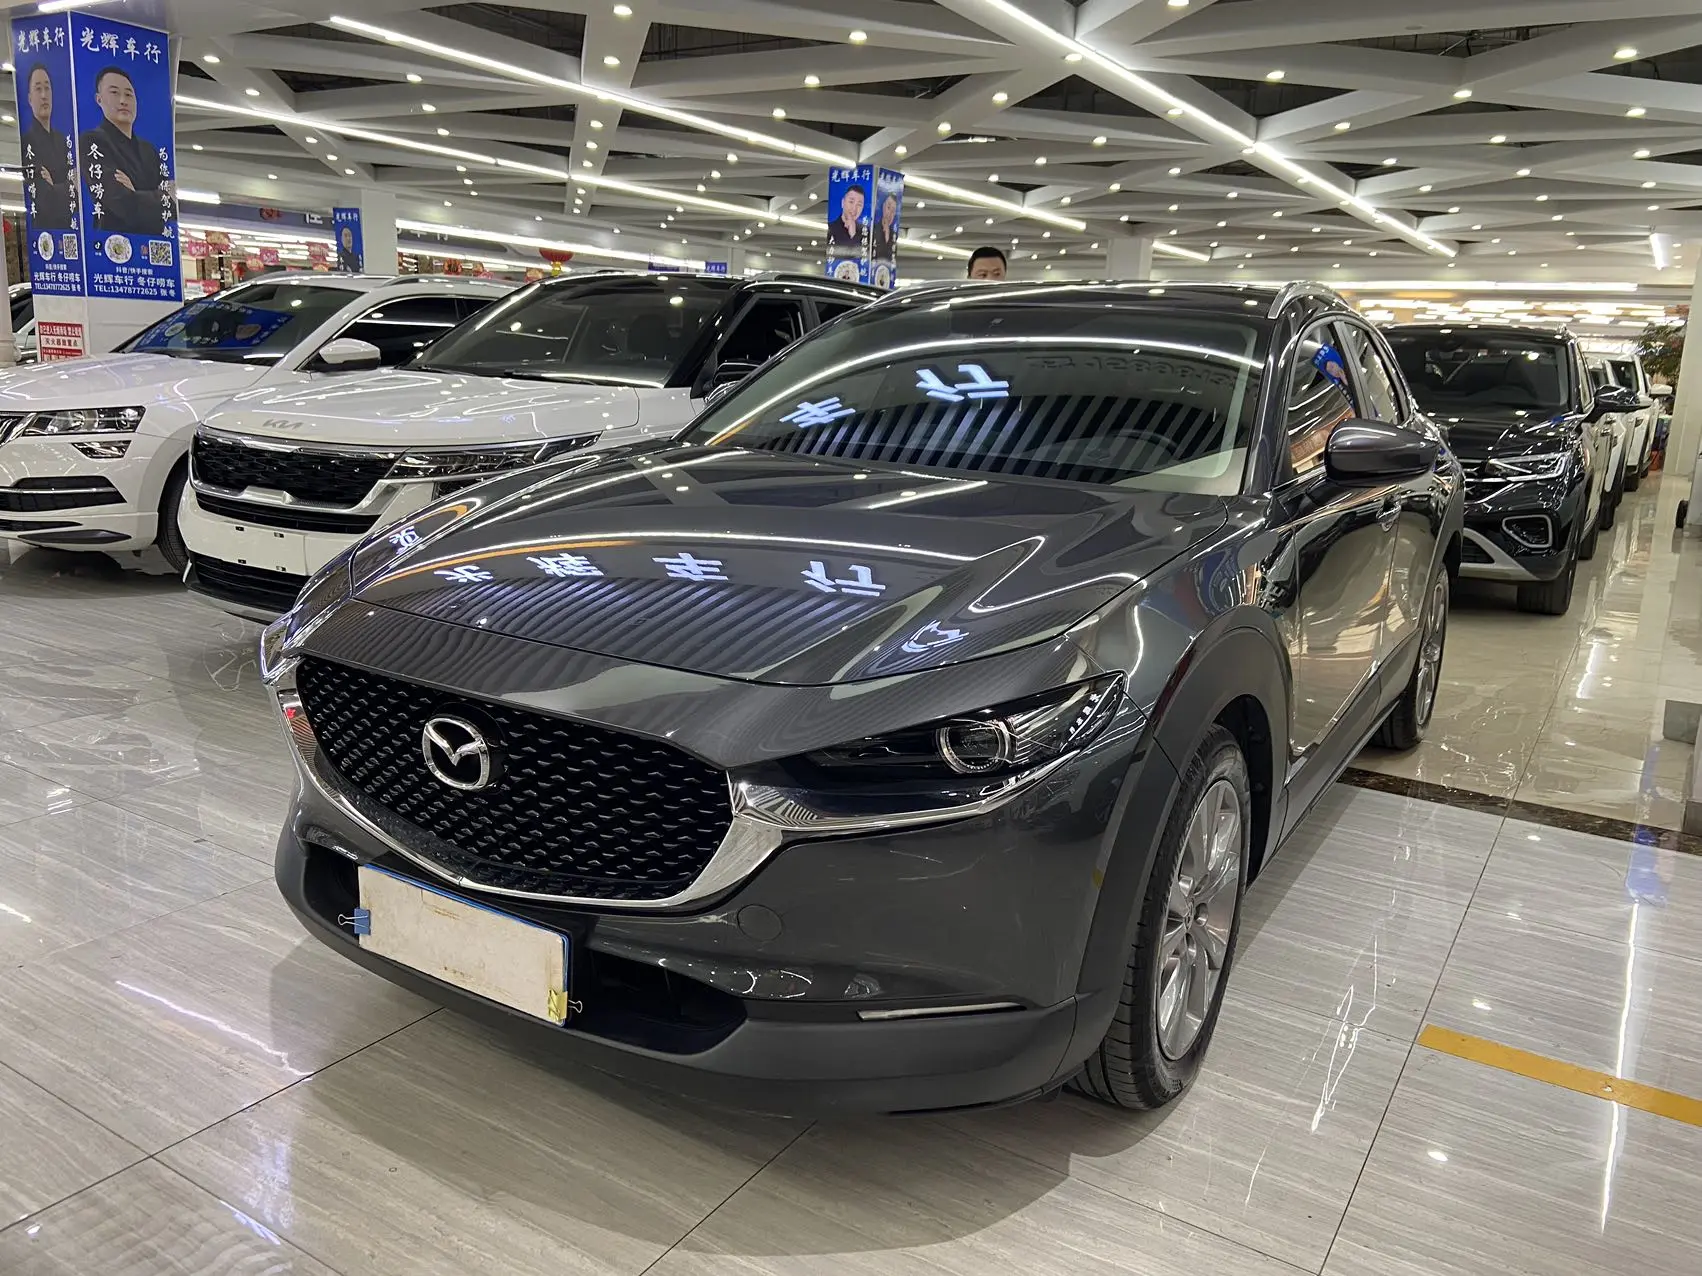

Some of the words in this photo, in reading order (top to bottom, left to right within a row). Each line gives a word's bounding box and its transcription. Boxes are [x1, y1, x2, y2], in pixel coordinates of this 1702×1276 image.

[17, 27, 66, 53] 光辉车行
[80, 27, 162, 64] 光辉车行
[87, 142, 105, 220] 冬仔唠车
[831, 169, 871, 183] 光辉车行
[159, 147, 175, 239] 为您保驾护航
[93, 273, 134, 286] 光辉车行
[137, 276, 176, 289] 冬仔唠车
[93, 285, 158, 296] TEL:13478772625
